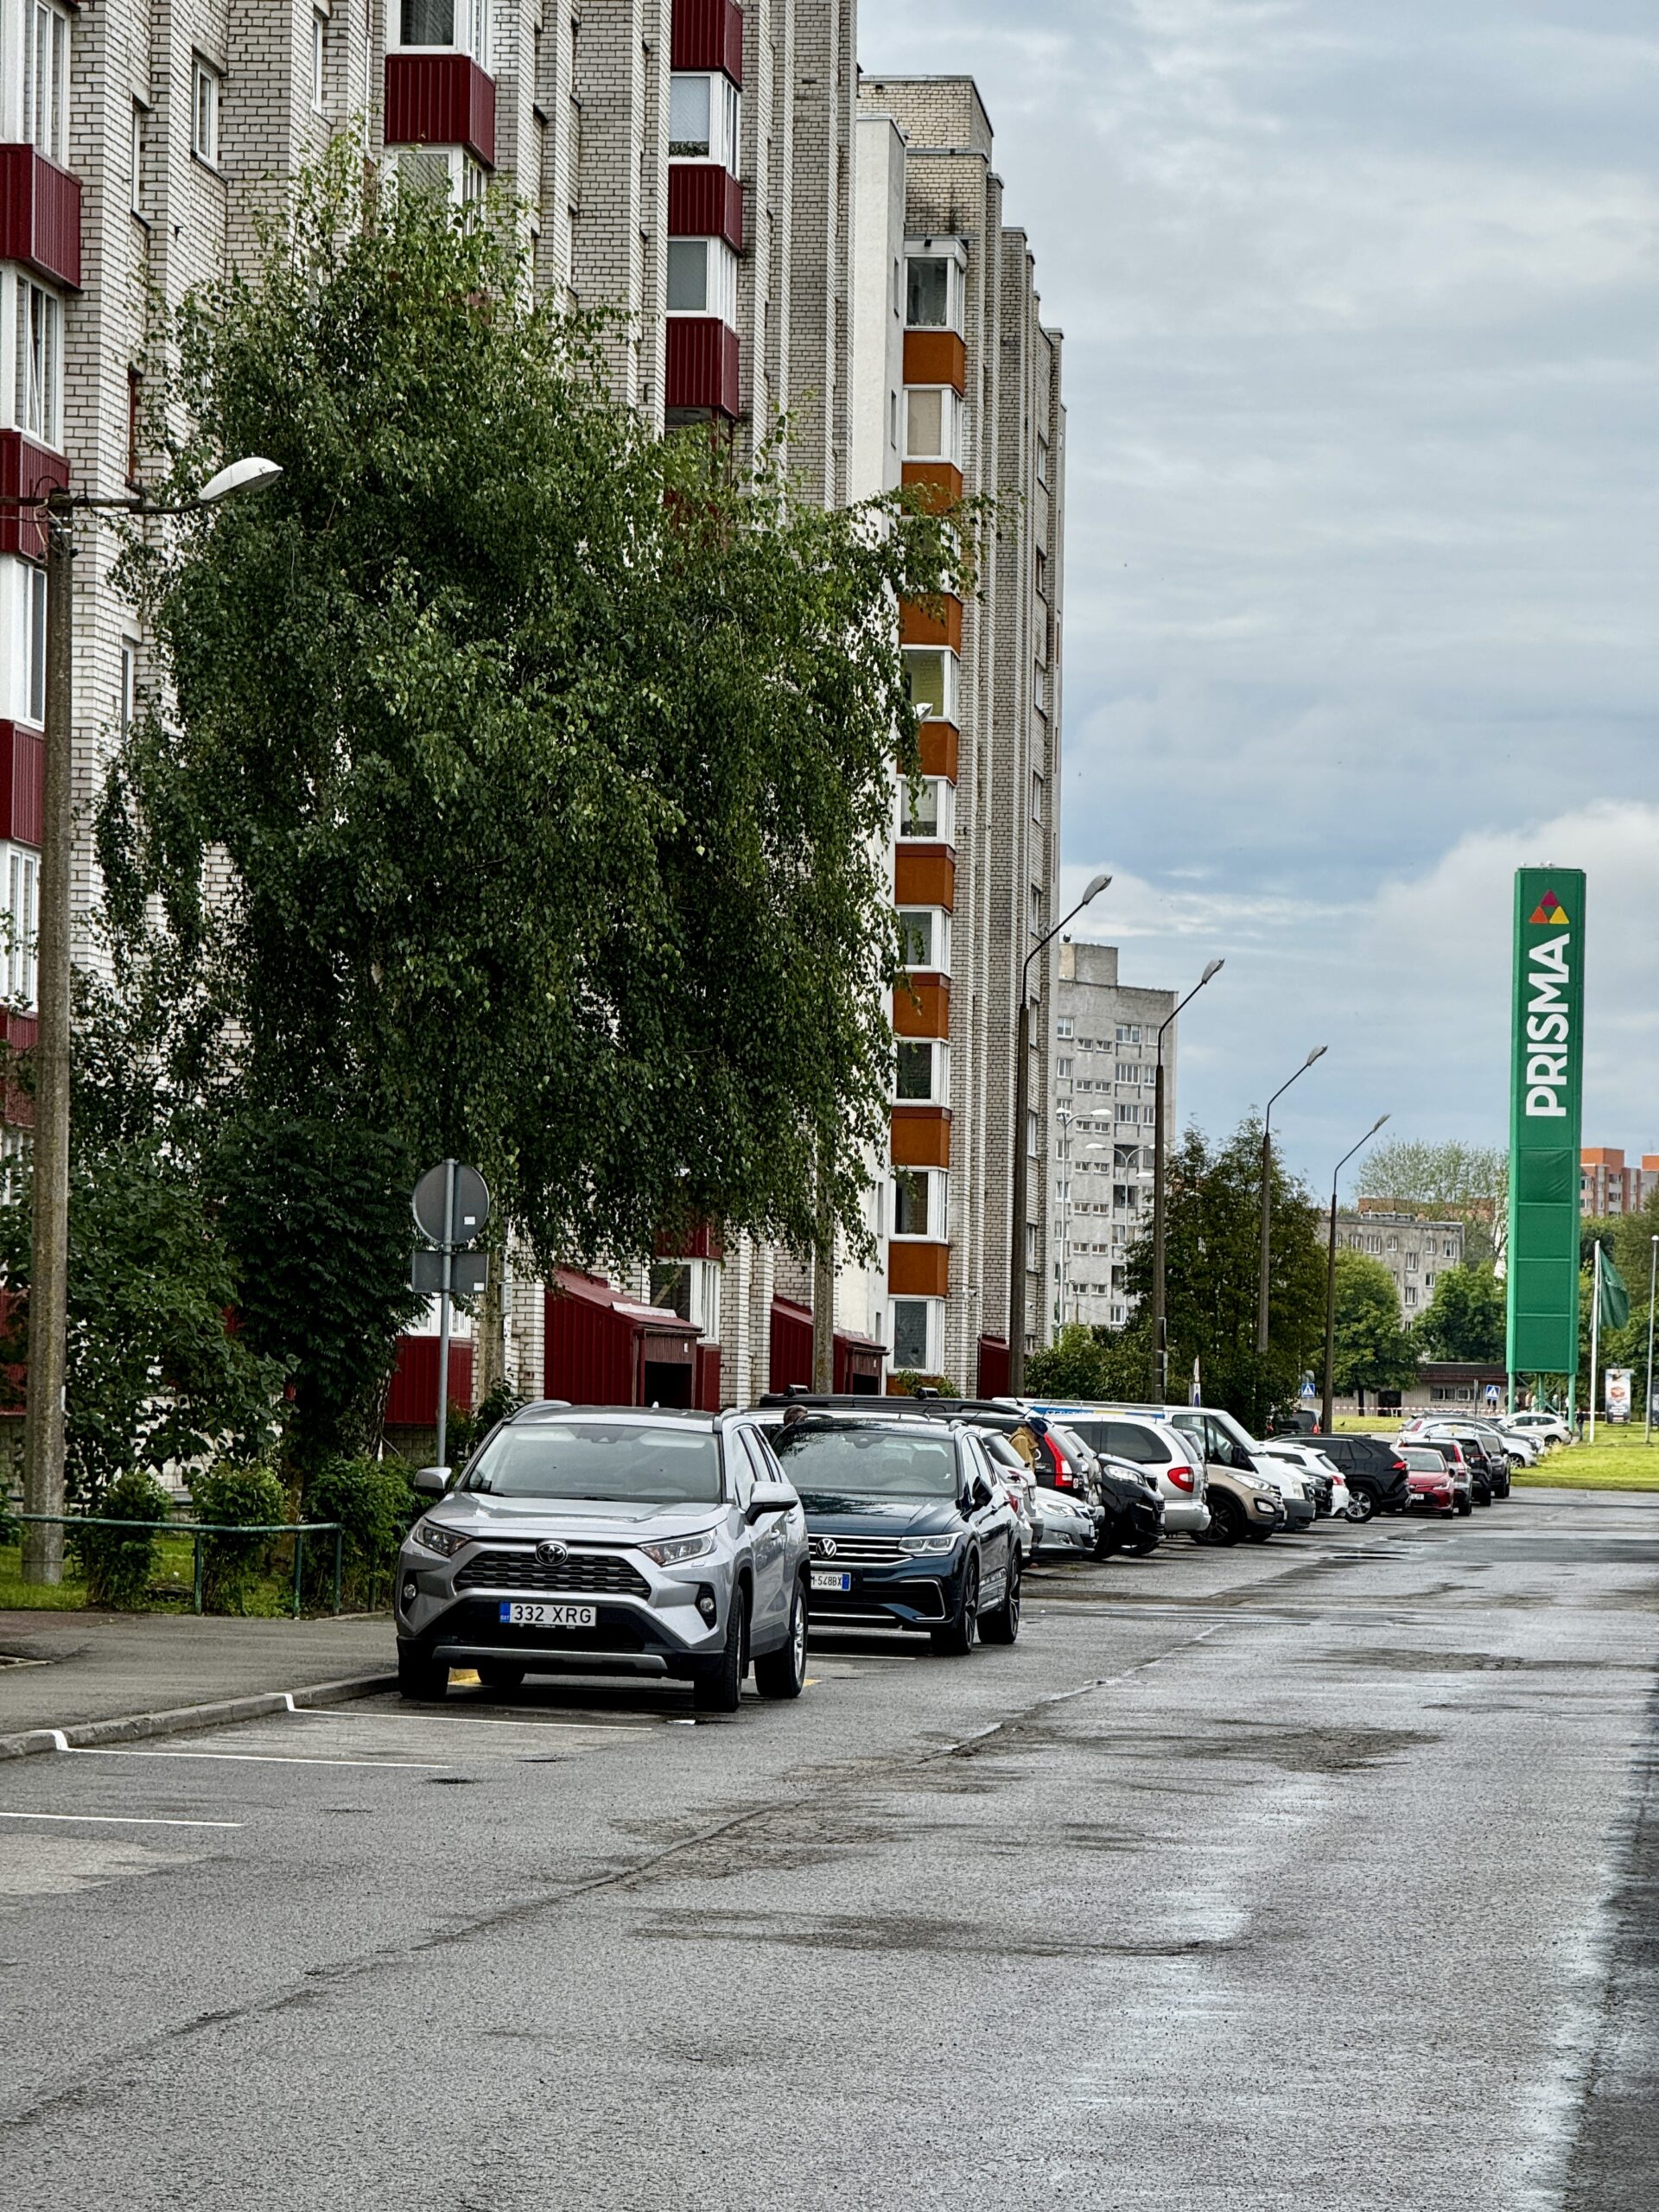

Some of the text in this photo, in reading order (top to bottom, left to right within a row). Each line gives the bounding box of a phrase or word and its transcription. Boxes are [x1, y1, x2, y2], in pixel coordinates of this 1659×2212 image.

[1525, 932, 1570, 1117] PRISMA
[514, 1605, 592, 1624] 332 XRG
